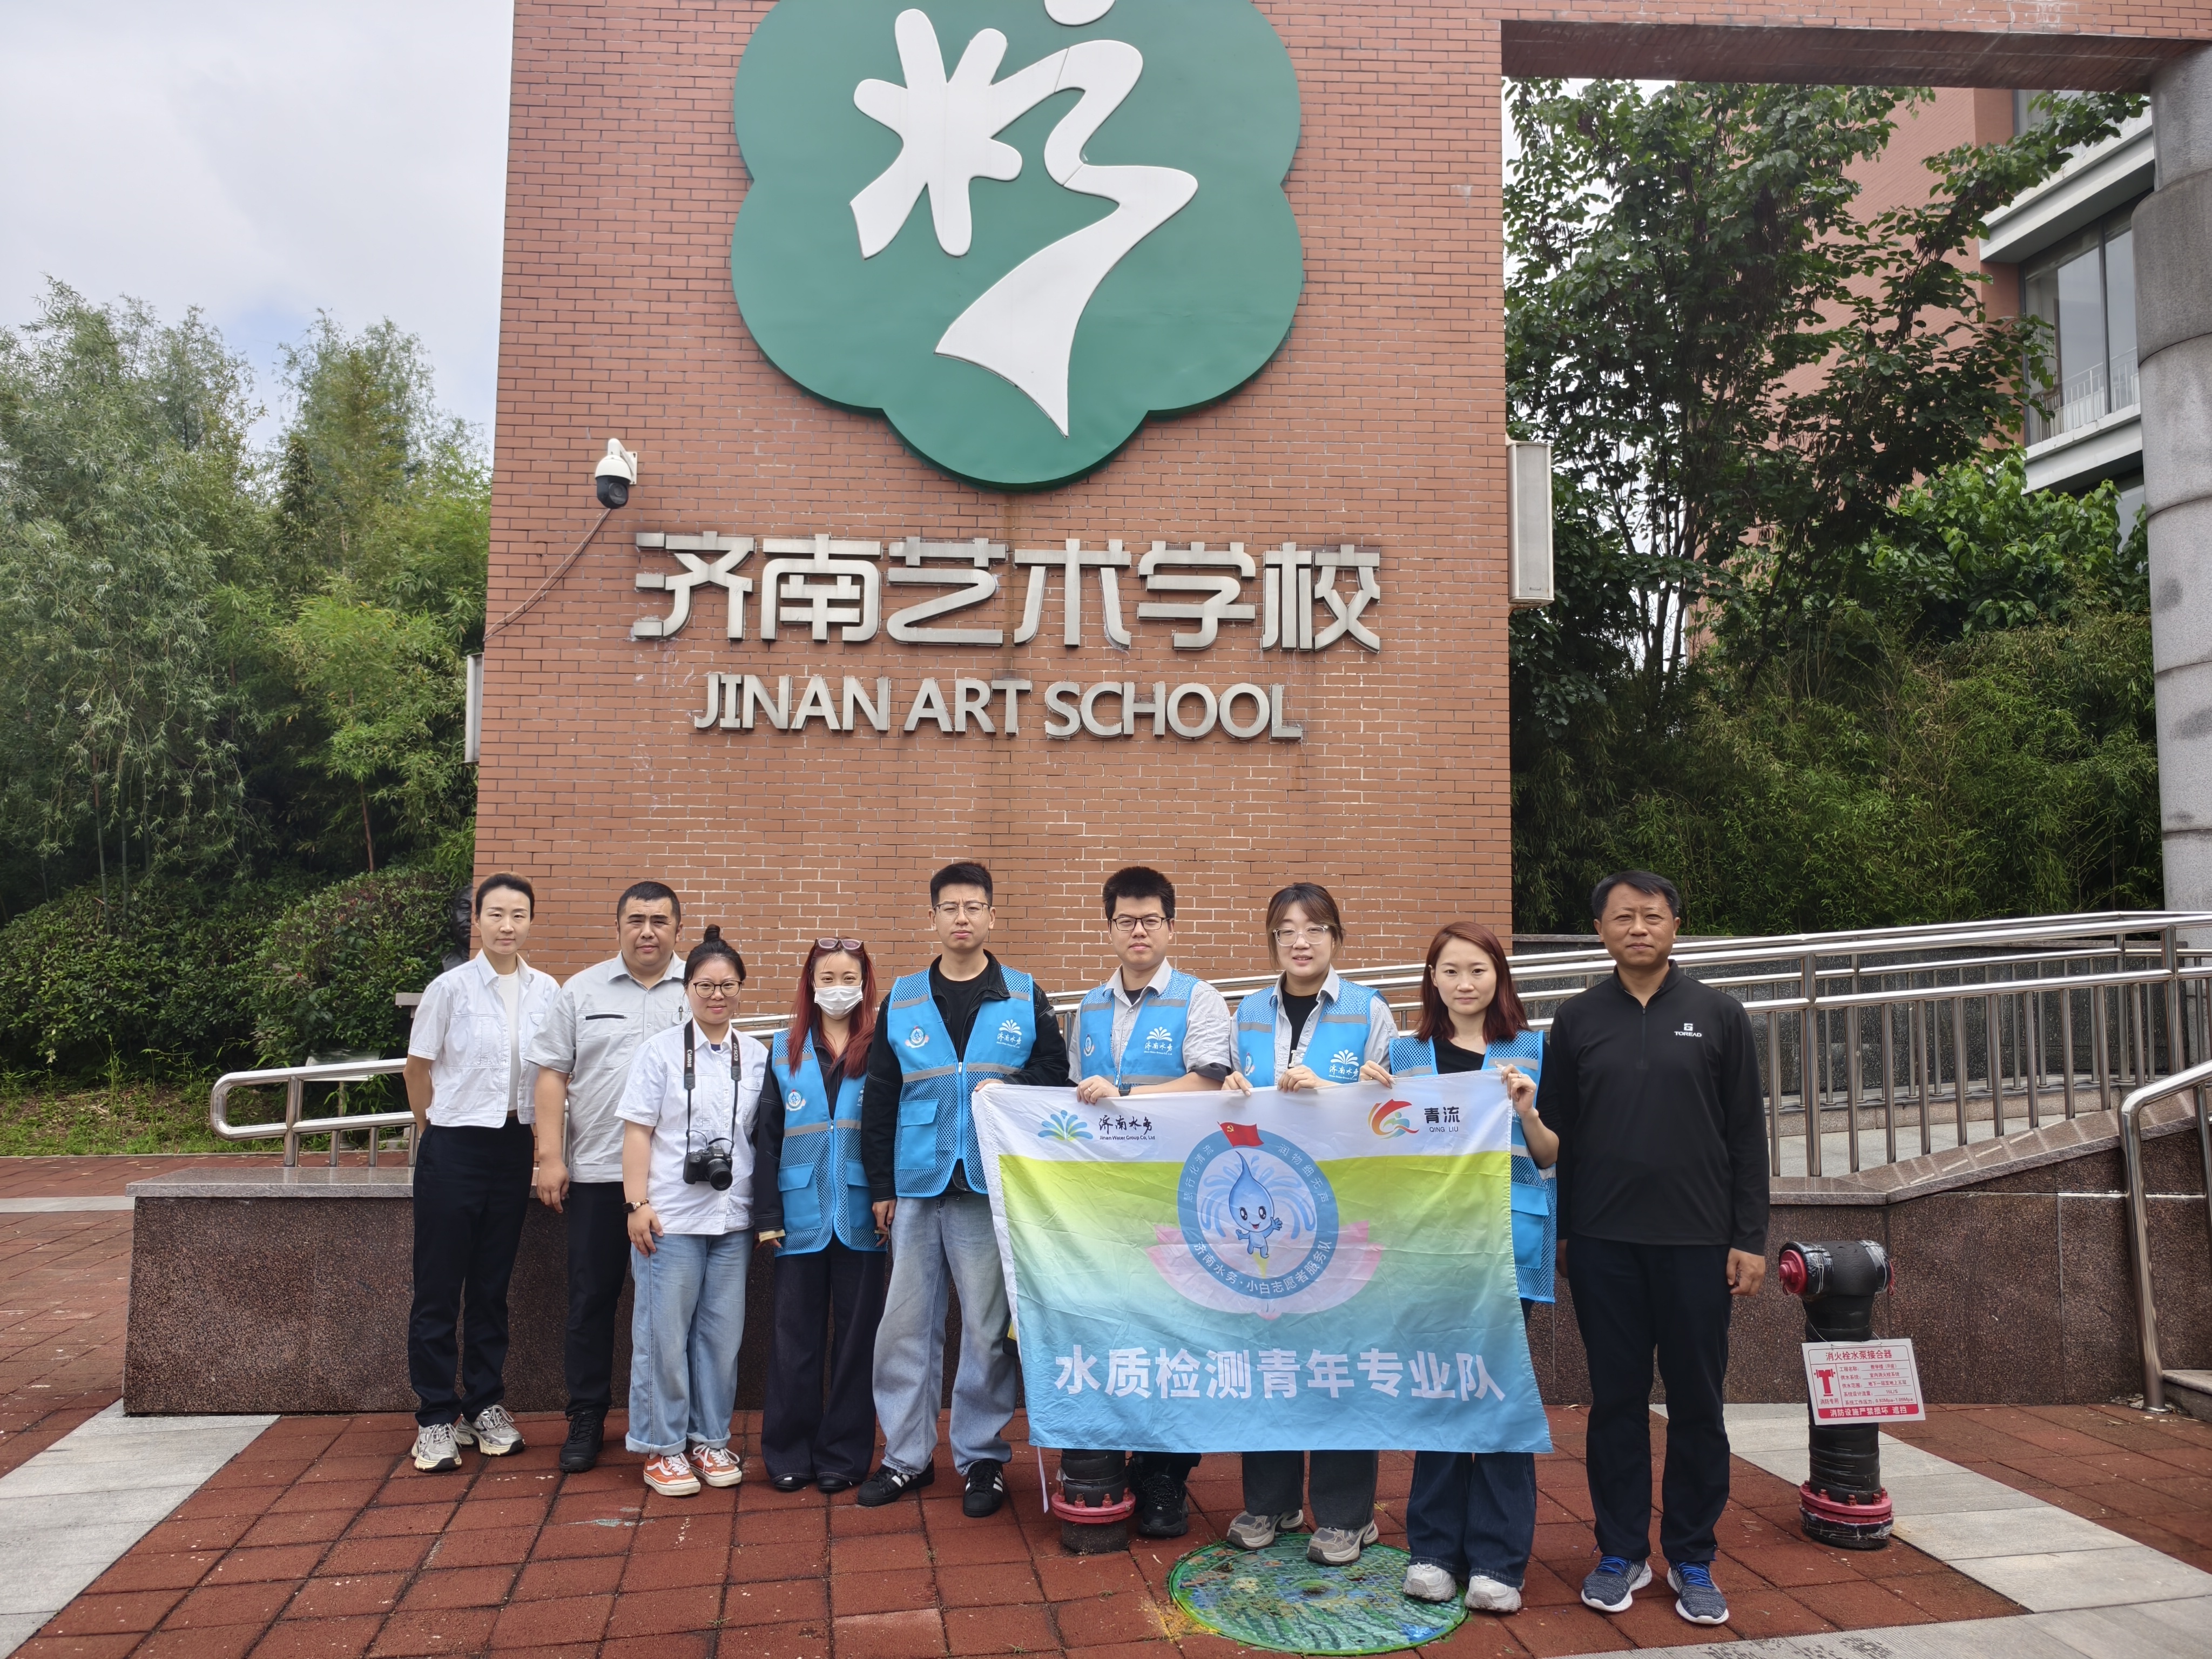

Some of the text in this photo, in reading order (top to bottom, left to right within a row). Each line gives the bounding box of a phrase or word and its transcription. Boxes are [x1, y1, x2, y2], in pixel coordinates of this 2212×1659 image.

[632, 531, 1381, 652] 济南艺术学校
[694, 673, 1301, 740] JINAN ART SCHOOL
[1098, 1115, 1152, 1135] 济南水务
[1424, 1106, 1460, 1123] 青流
[1278, 1143, 1329, 1203] 润物细无声
[1054, 1344, 1506, 1403] 水质检测青年专业队
[1825, 1349, 1892, 1361] 消火栓水泵接合器
[1830, 1406, 1907, 1417] 消防设施严禁损坏 遮挡
